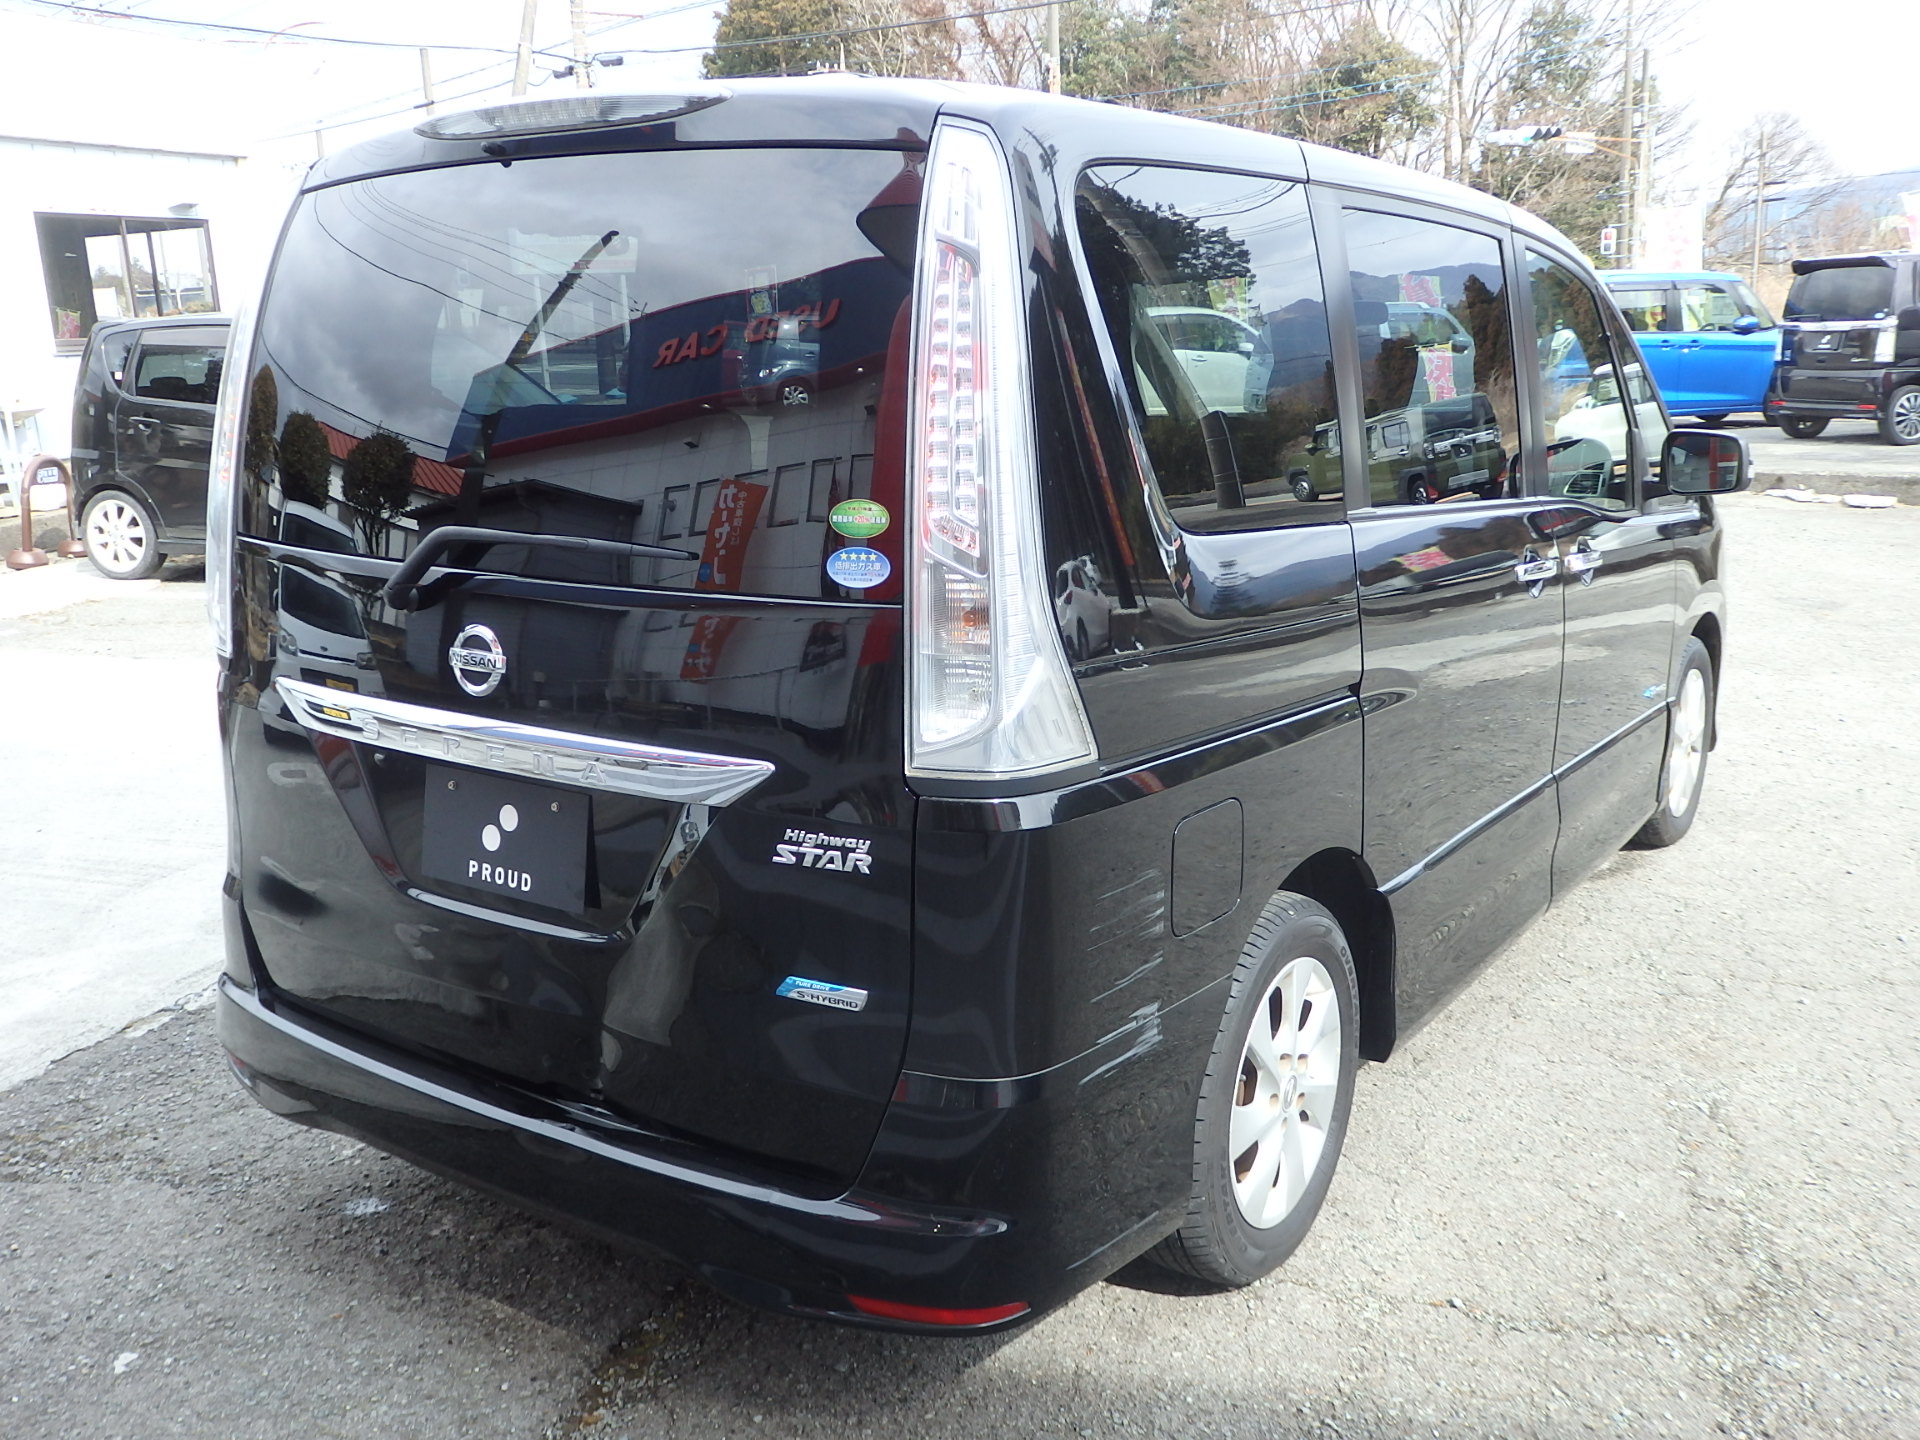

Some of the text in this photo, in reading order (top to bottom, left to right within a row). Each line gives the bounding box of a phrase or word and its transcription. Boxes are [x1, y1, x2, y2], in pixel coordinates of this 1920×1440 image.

[451, 652, 497, 669] NISSAN
[361, 718, 607, 784] SERENA
[784, 828, 871, 853] Highway
[772, 843, 872, 874] STAR
[468, 859, 532, 891] PROUD
